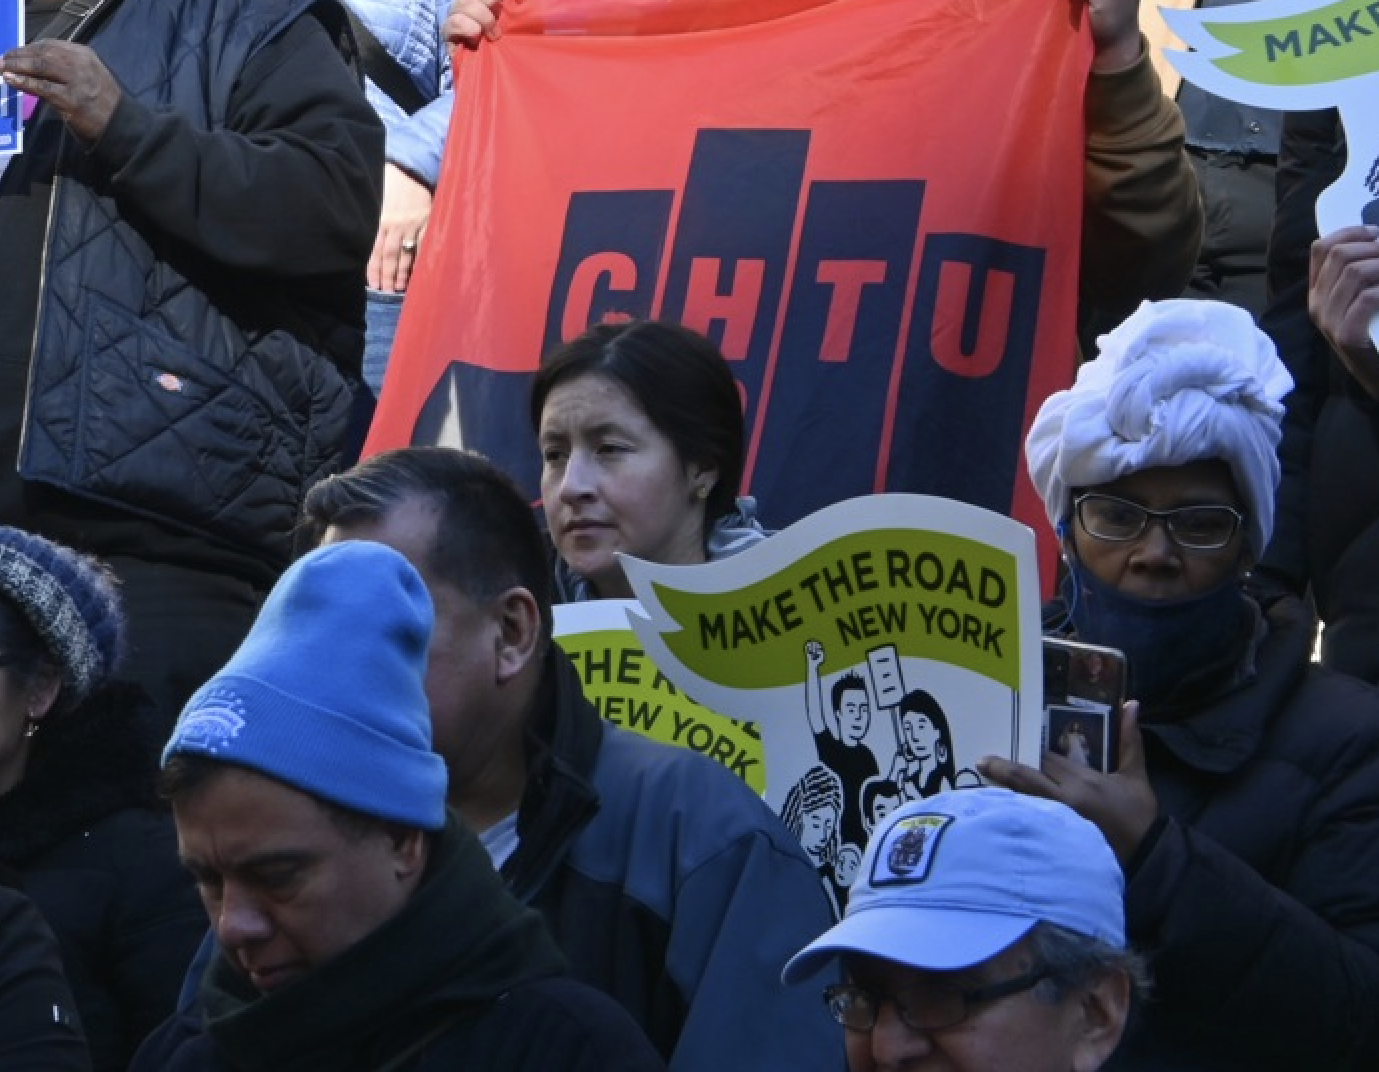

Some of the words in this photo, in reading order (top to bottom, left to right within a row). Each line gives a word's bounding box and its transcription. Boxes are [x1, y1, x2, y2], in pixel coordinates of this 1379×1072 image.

[698, 589, 804, 650] MAKE
[800, 551, 879, 612] THE
[886, 549, 1007, 609] ROAD
[835, 601, 908, 647] NEW
[917, 601, 1007, 658] YORK
